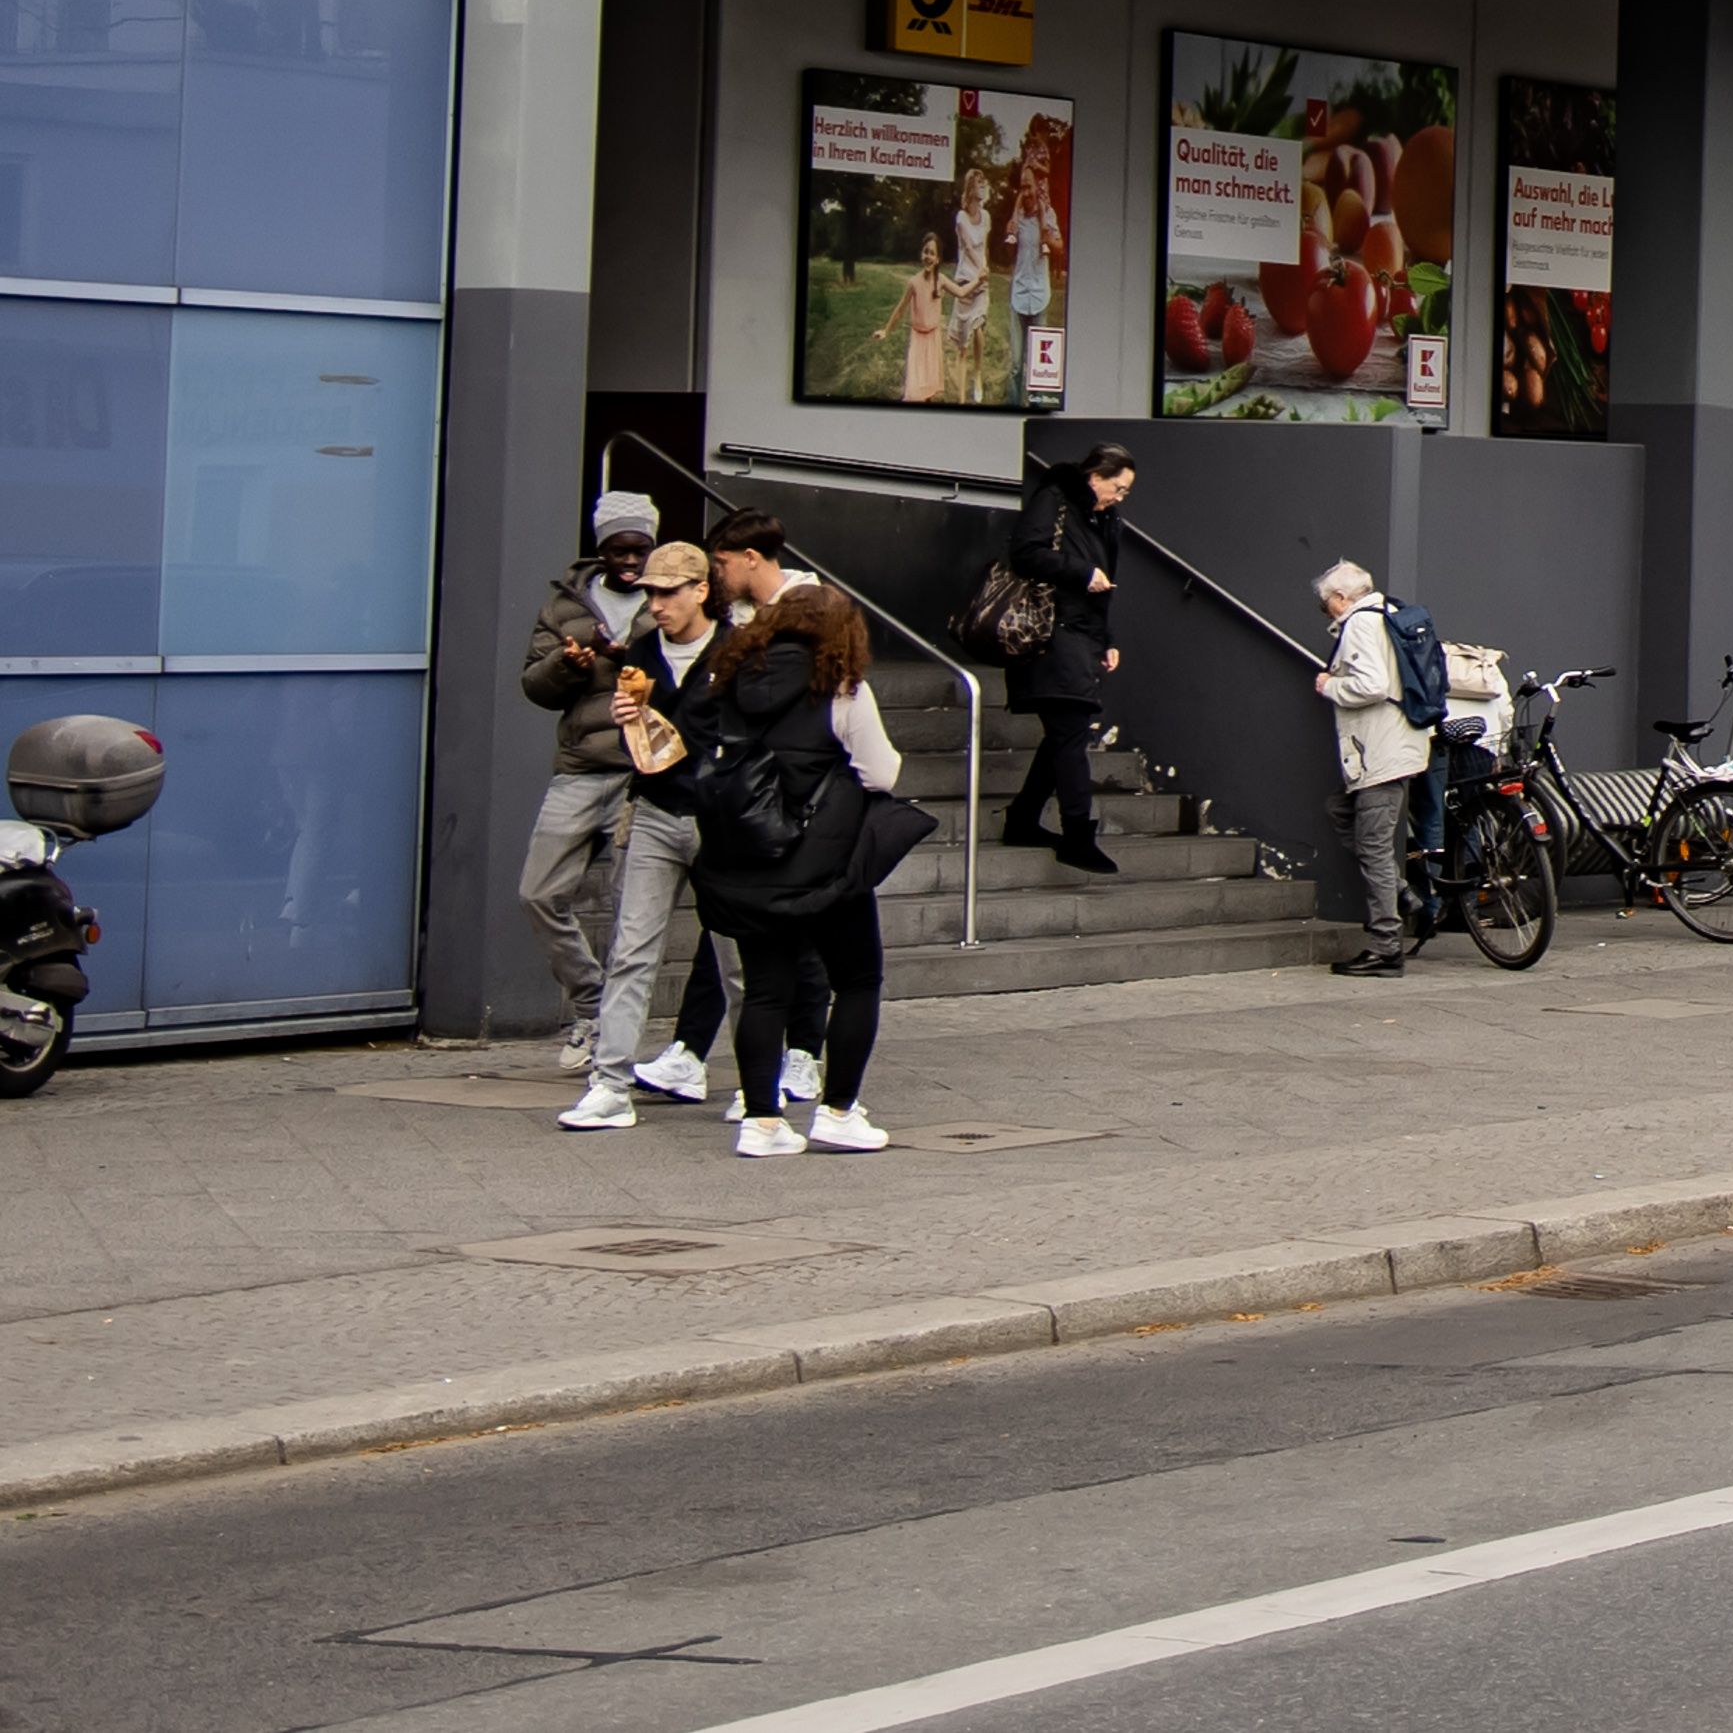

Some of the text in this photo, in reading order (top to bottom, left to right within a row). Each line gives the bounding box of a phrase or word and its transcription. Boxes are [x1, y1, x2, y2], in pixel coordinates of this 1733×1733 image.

[814, 116, 950, 148] Herzlich willkommen
[813, 141, 935, 169] in Ihrem Kaufland.
[1177, 138, 1279, 172] Qualität, die
[1176, 175, 1294, 204] man schmeckt.
[1513, 177, 1574, 207] Auswahl,
[1578, 185, 1599, 207] die
[1513, 207, 1538, 228] auf
[1541, 210, 1576, 232] mehr
